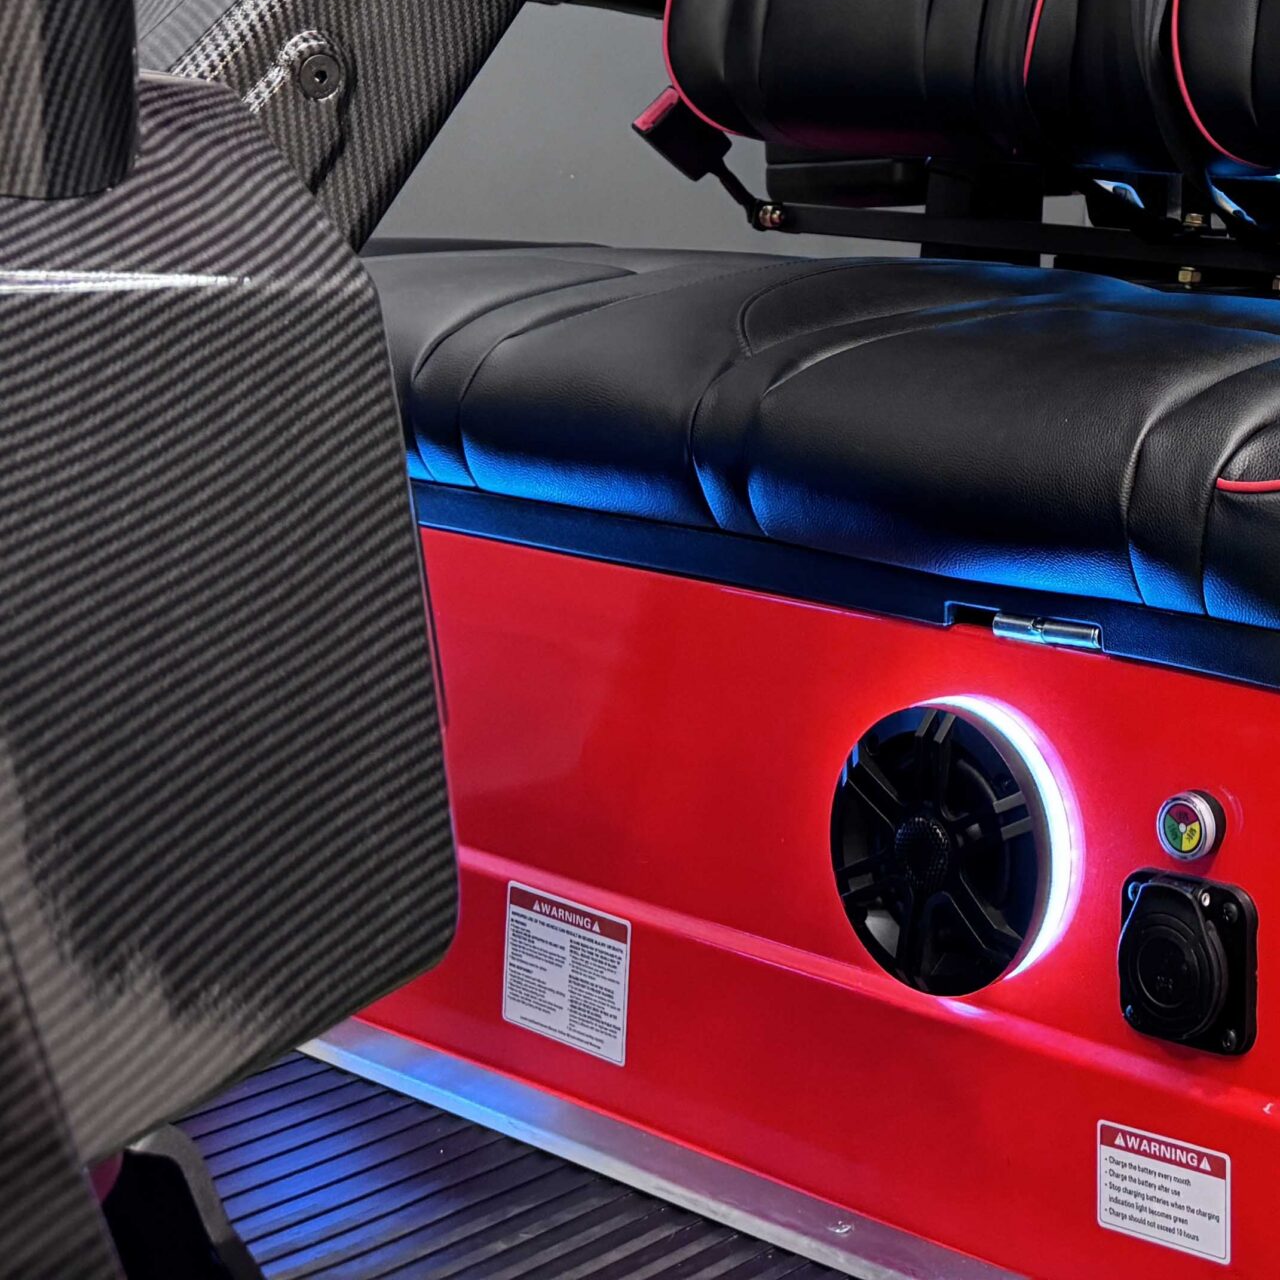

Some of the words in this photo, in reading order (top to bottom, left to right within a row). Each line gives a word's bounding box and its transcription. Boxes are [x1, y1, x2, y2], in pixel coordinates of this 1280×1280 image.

[541, 902, 592, 930] WARNING
[1126, 1134, 1198, 1167] WARNING
[1109, 1155, 1127, 1169] Charge
[1128, 1162, 1137, 1171] the
[1138, 1164, 1157, 1179] battery
[1158, 1172, 1172, 1182] every
[1173, 1176, 1192, 1187] month
[1109, 1168, 1127, 1182] Charge
[1128, 1175, 1137, 1184] the
[1138, 1177, 1157, 1191] battery
[1158, 1184, 1170, 1193] after
[1171, 1189, 1181, 1197] use
[1109, 1181, 1121, 1193] Stop
[1122, 1186, 1145, 1201] charging
[1146, 1193, 1169, 1207] batteries
[1170, 1201, 1185, 1211] when
[1186, 1205, 1195, 1214] the
[1195, 1208, 1220, 1223] charging
[1135, 1202, 1148, 1213] light
[1148, 1206, 1172, 1220] becomes
[1173, 1215, 1188, 1225] green
[1109, 1207, 1127, 1221] Charge
[1128, 1214, 1146, 1226] should
[1146, 1220, 1156, 1229] not
[1157, 1223, 1176, 1235] exceed
[1183, 1230, 1200, 1242] hours
